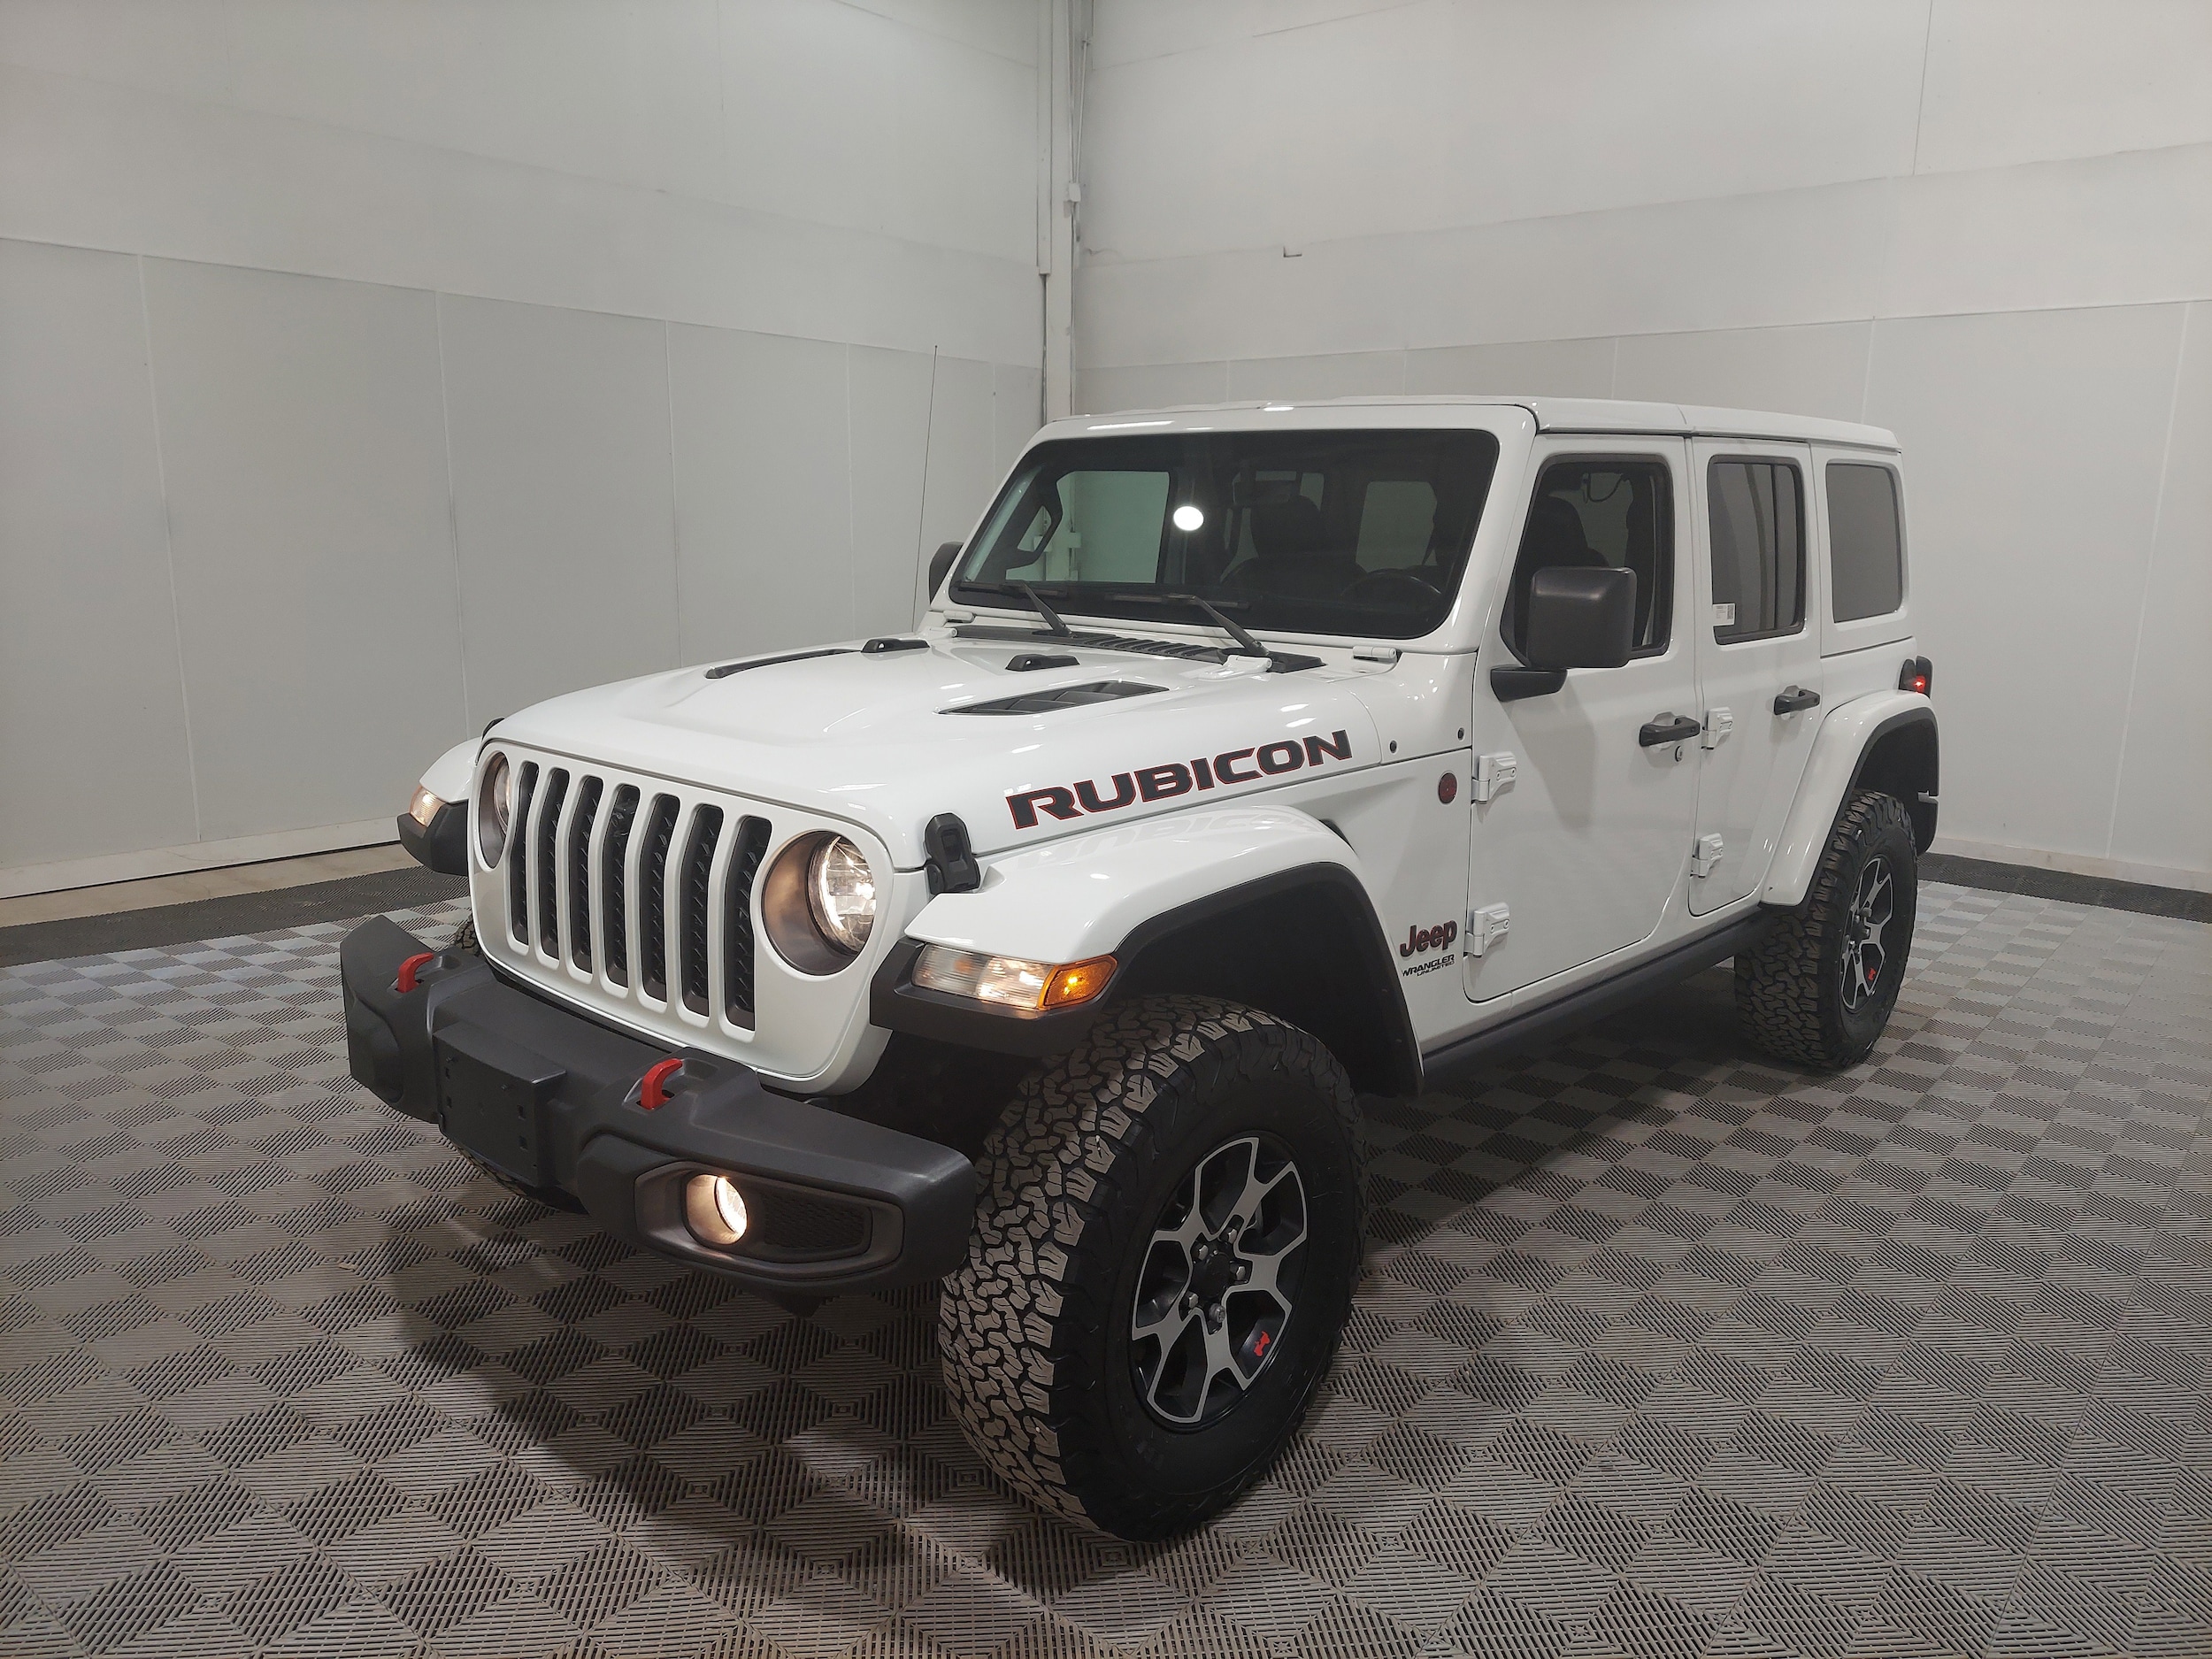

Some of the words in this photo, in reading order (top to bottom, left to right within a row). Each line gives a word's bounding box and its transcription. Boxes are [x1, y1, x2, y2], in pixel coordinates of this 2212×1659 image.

[1005, 729, 1353, 830] RUBICON
[1400, 919, 1458, 957] Jeep
[1402, 954, 1455, 977] WRANGLER
